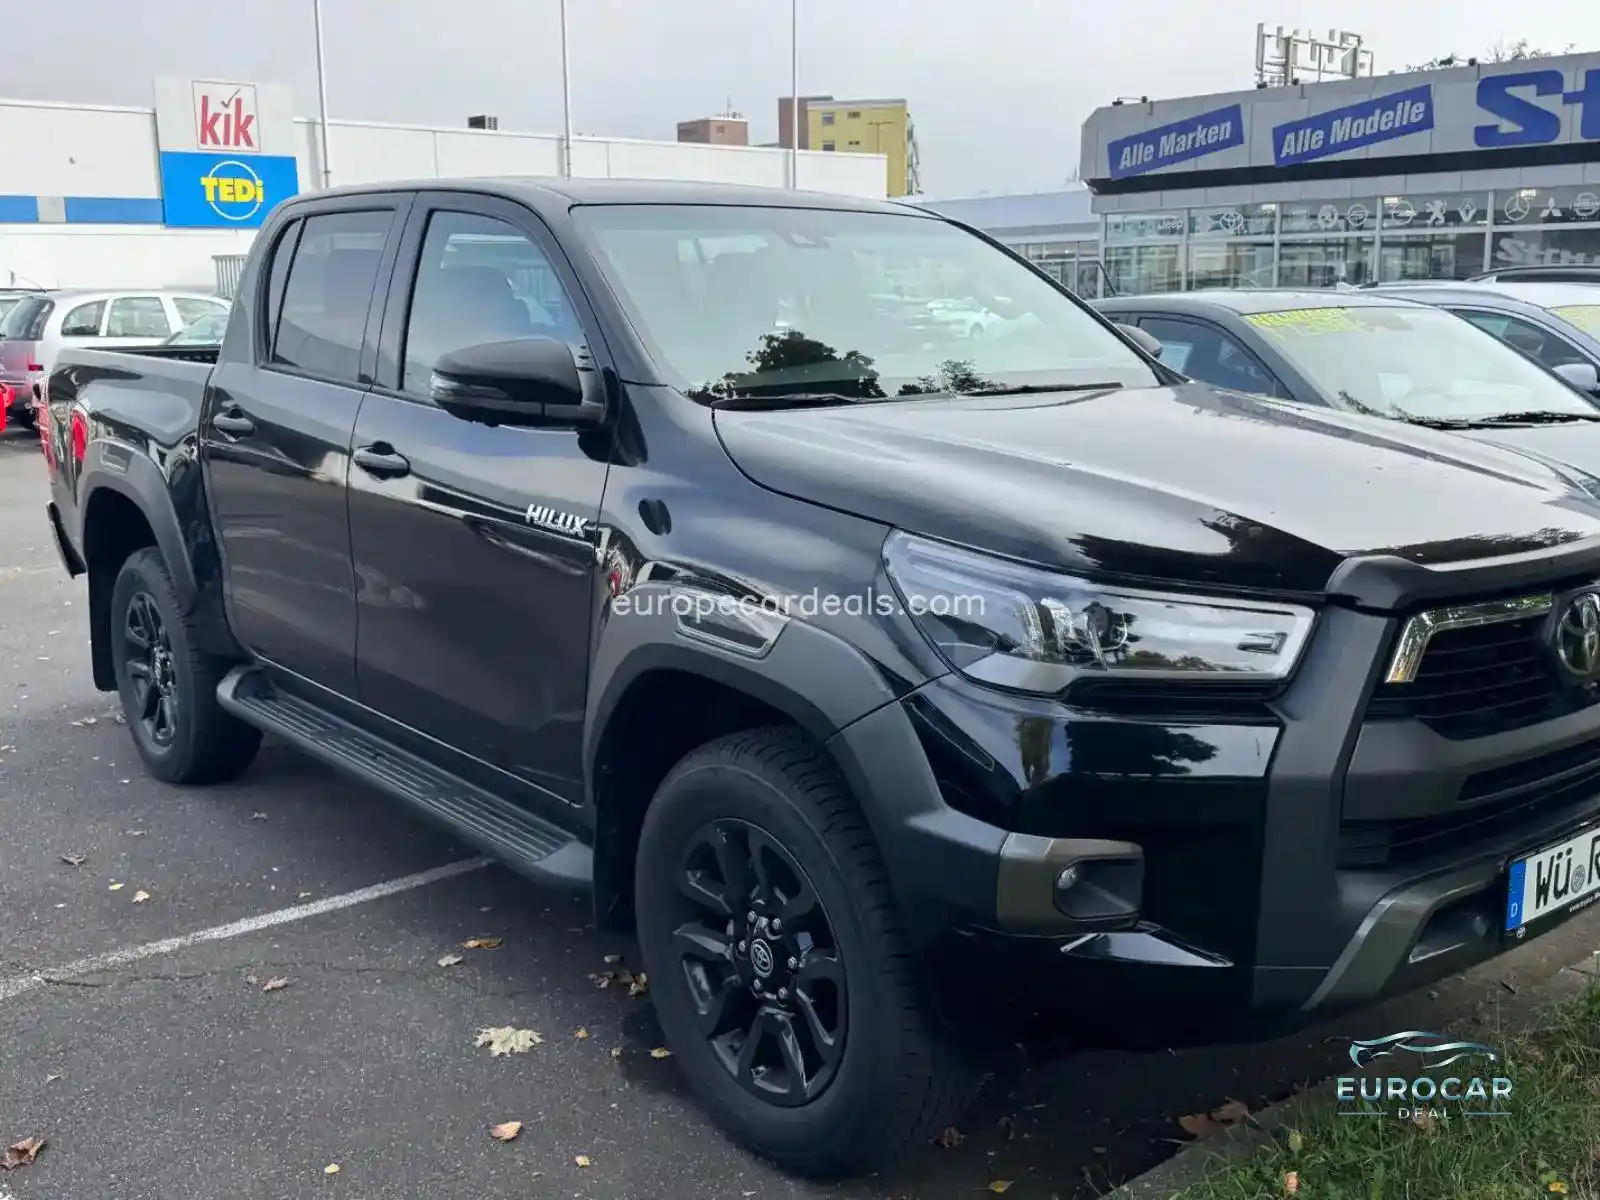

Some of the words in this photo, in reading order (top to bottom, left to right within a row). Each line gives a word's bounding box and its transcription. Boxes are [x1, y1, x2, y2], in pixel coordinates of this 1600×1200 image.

[1119, 142, 1154, 170] Alle
[1158, 119, 1232, 160] Marken
[1280, 130, 1324, 159] Alle
[1330, 100, 1426, 145] Modelle
[200, 176, 264, 203] TEDi
[525, 503, 588, 538] HILUX
[1510, 902, 1518, 918] D
